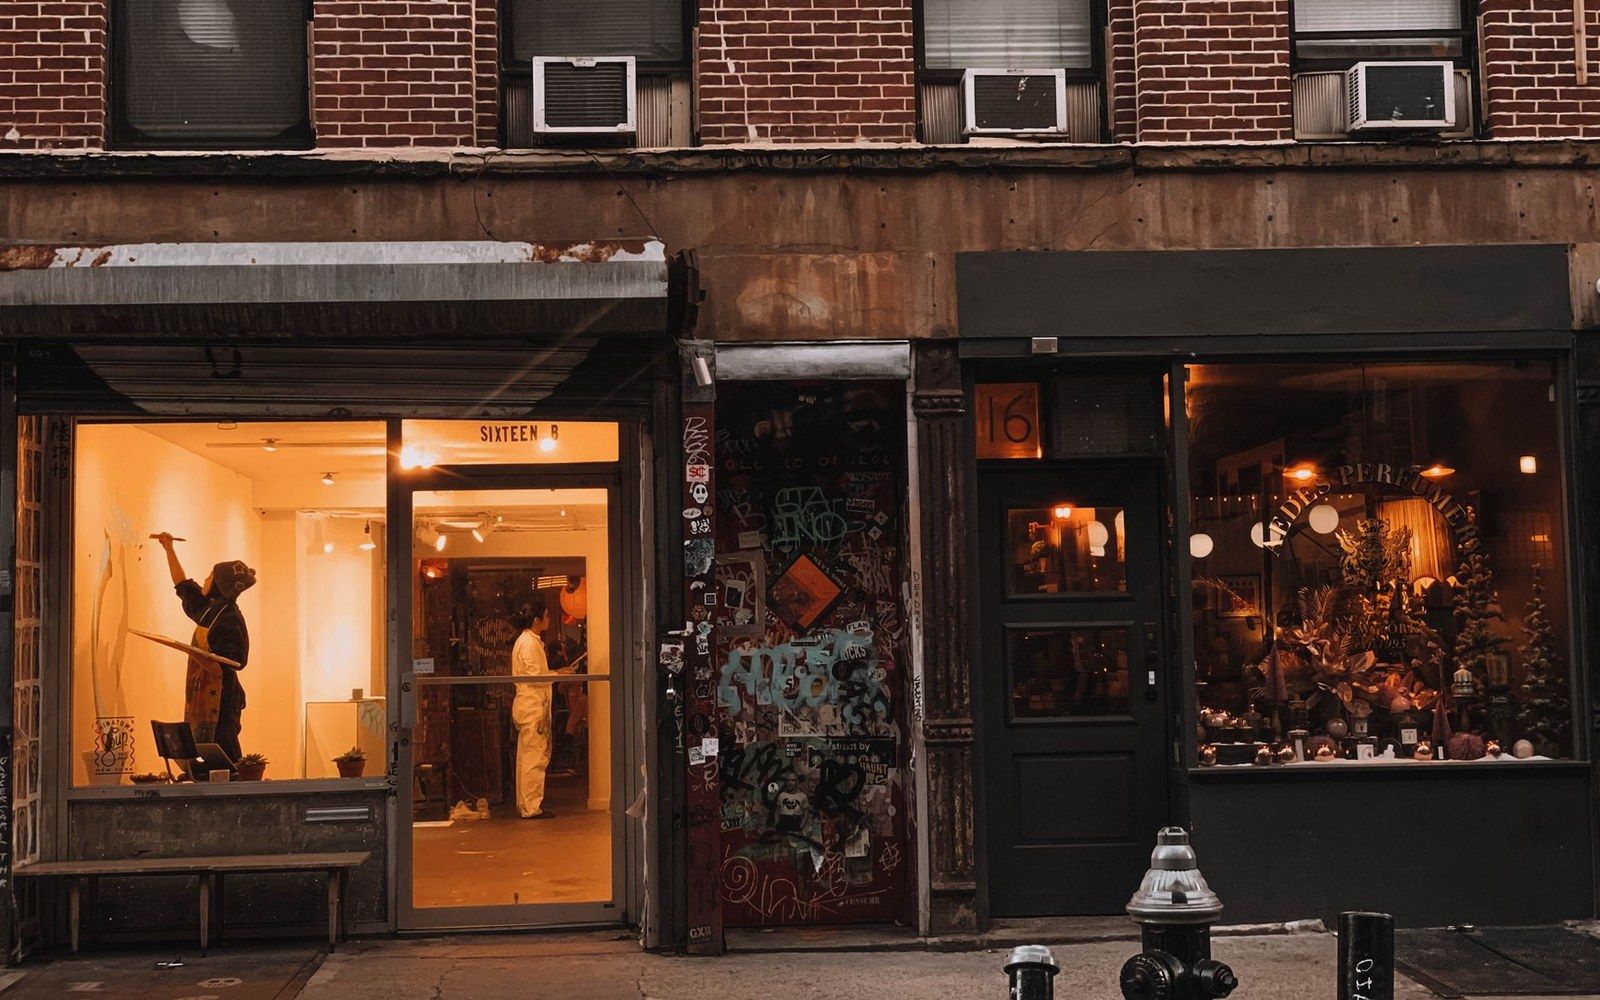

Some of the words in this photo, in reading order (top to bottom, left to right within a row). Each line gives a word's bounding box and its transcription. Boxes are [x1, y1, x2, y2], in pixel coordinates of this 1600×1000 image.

[480, 425, 538, 442] SIXTEEN
[988, 395, 1032, 444] 16
[1262, 476, 1333, 558] AEDES
[94, 719, 135, 735] CHINATOWN
